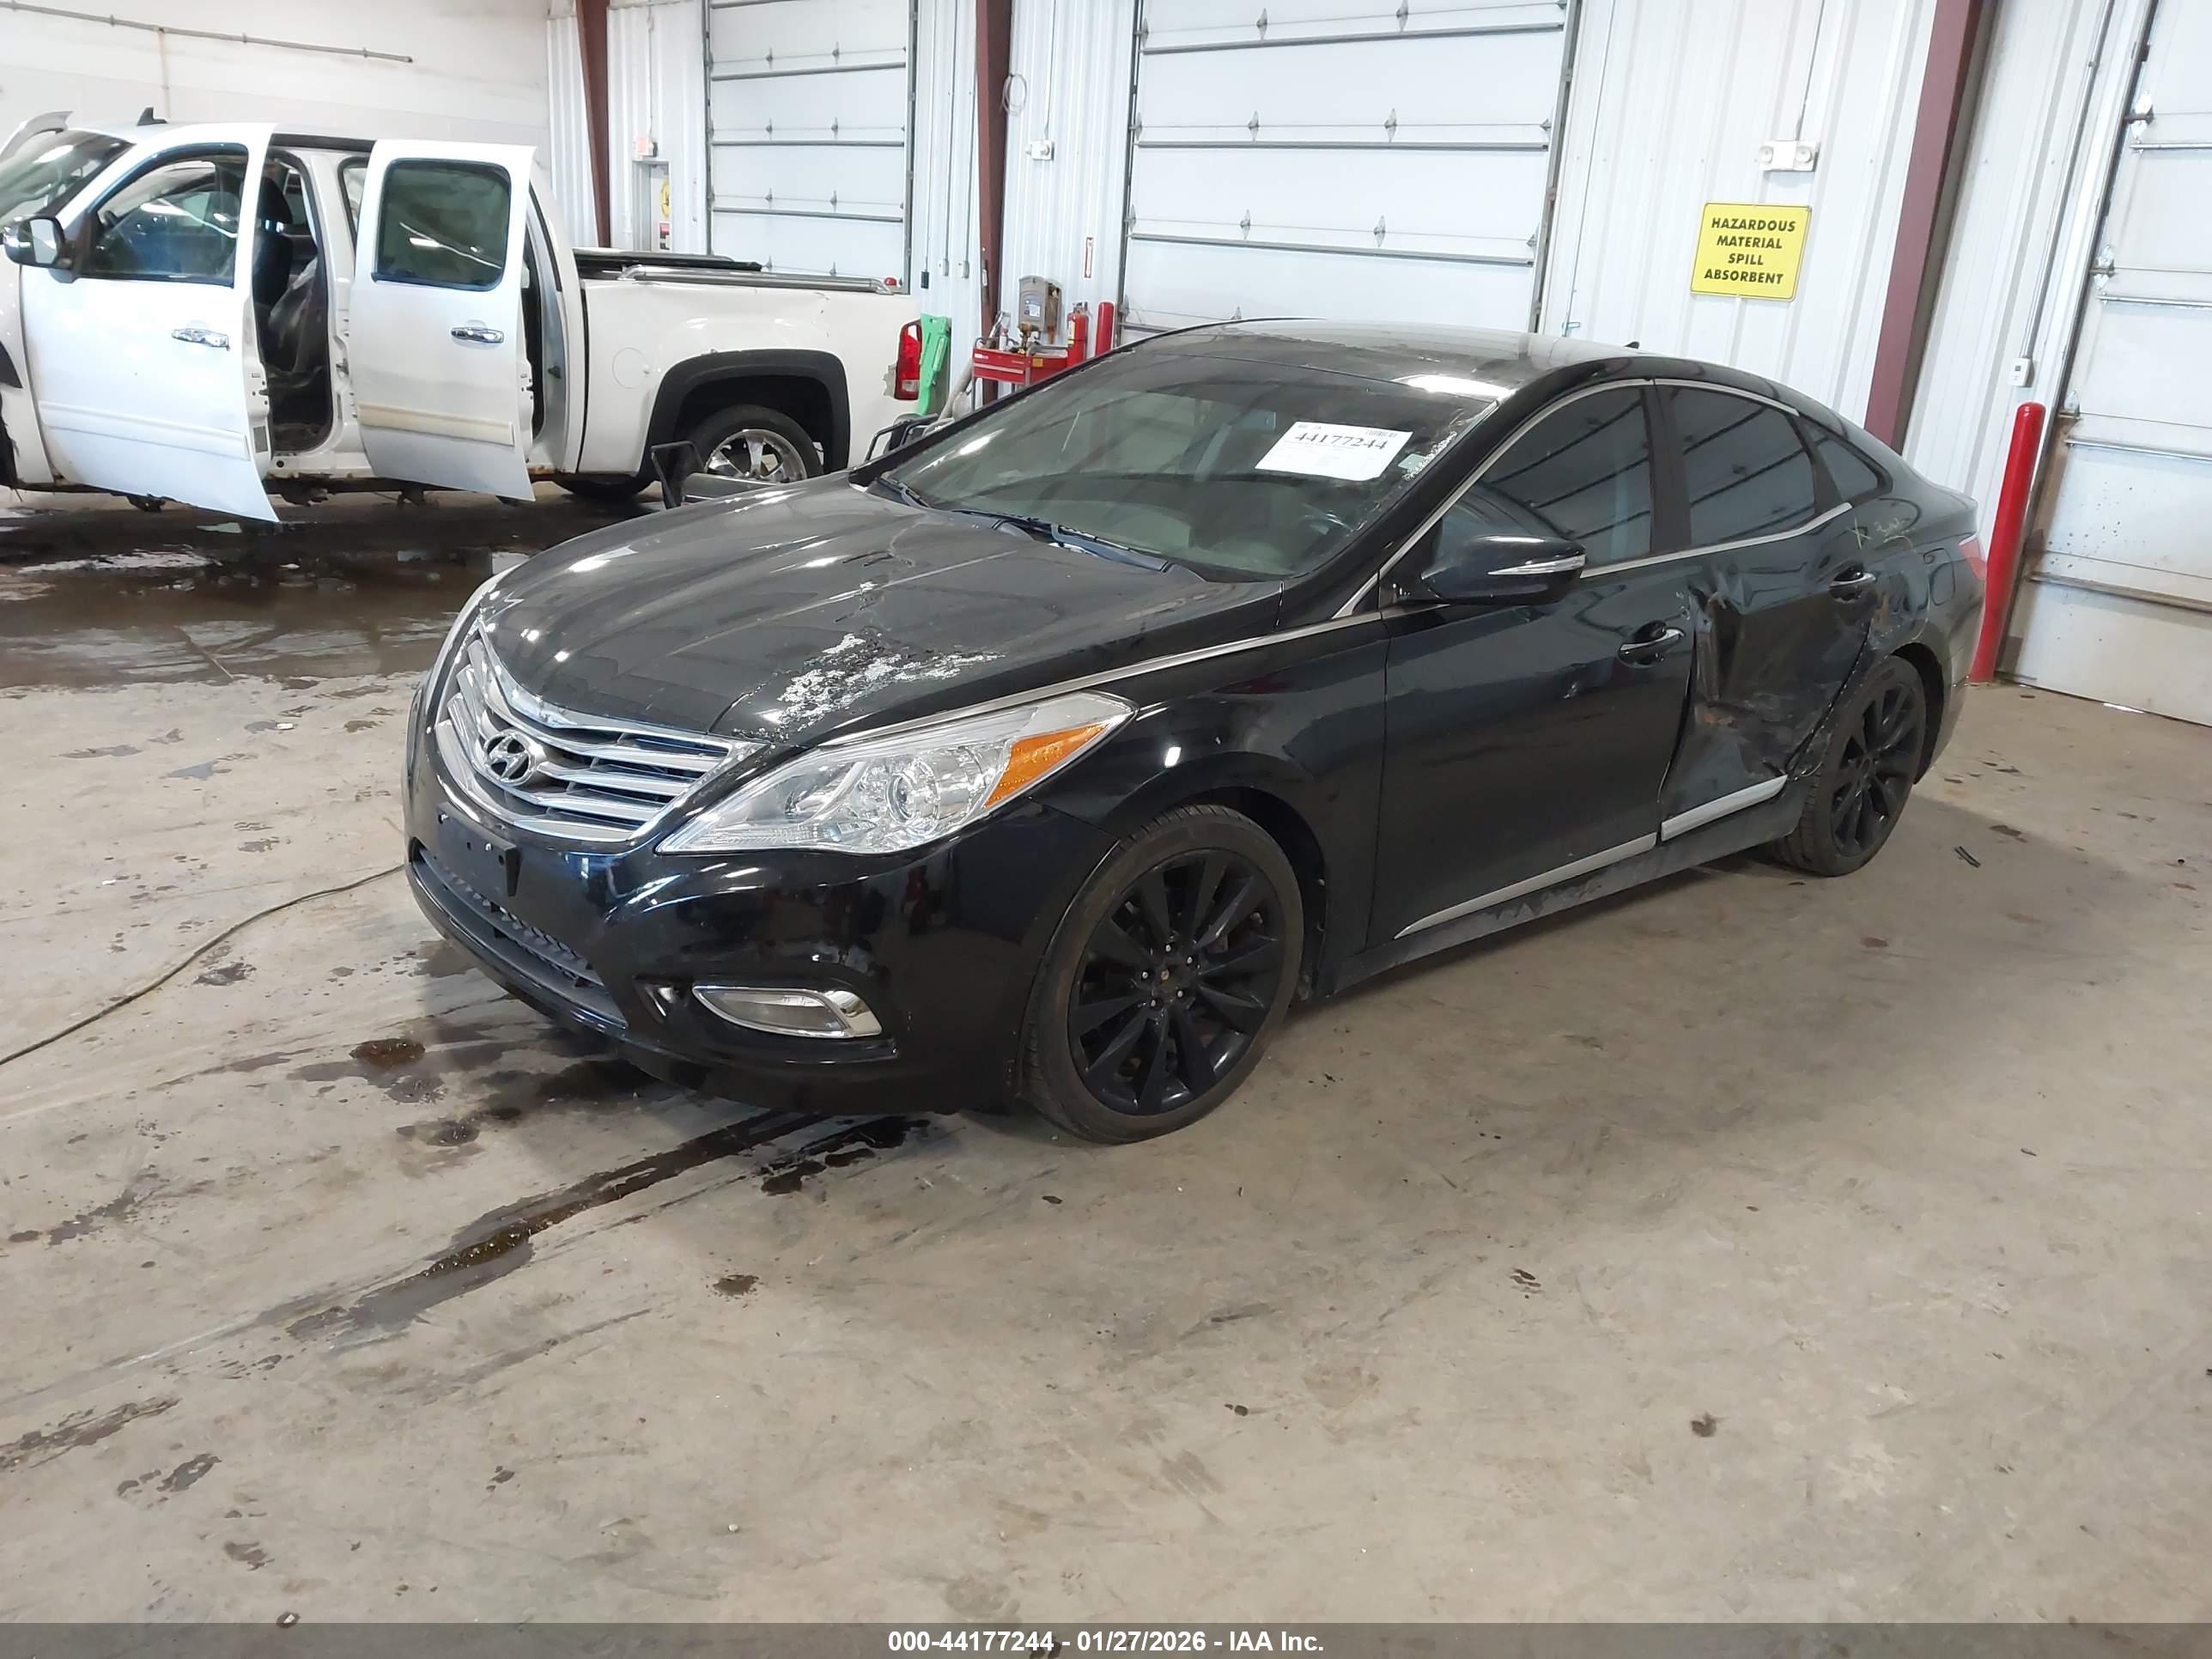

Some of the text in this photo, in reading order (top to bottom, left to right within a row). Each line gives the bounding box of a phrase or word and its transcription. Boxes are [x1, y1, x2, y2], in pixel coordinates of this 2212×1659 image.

[1711, 217, 1796, 232] HAZARDOUS
[1717, 235, 1783, 249] MATERIAL
[1728, 252, 1764, 265] SPILL
[1704, 268, 1784, 284] ABSORBENT
[1295, 432, 1389, 450] 44177244
